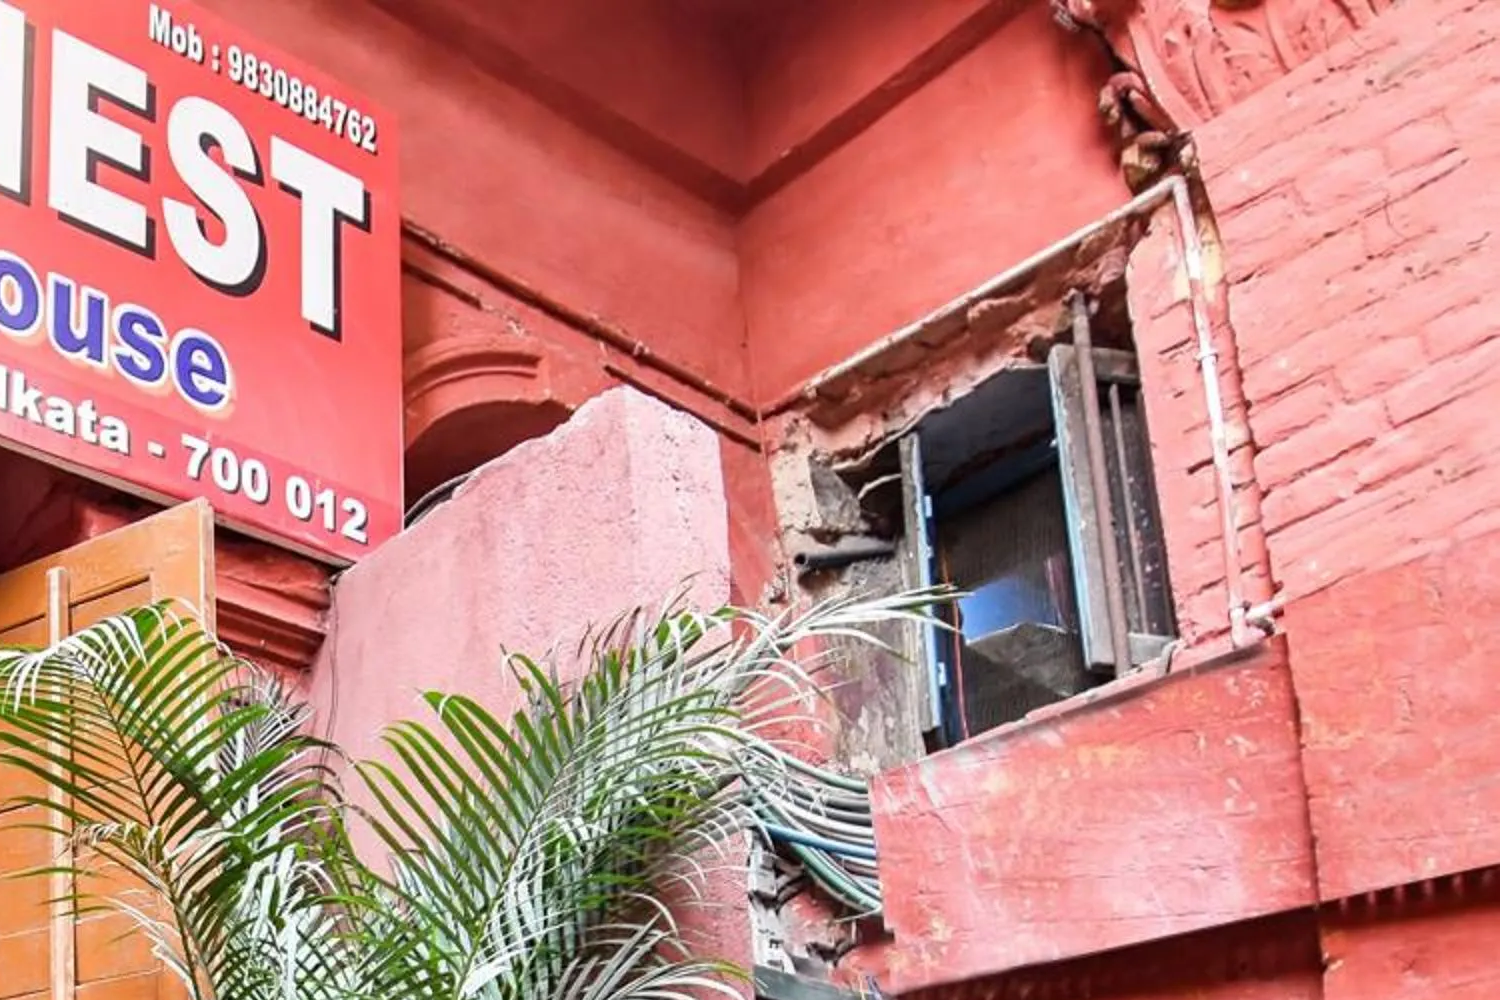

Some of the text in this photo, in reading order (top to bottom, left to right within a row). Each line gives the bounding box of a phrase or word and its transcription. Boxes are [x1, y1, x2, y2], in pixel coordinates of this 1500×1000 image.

[148, 3, 204, 64] Mob
[227, 45, 379, 155] 9830884762
[146, 442, 166, 459] -
[181, 432, 270, 503] 700
[285, 475, 370, 543] 012
